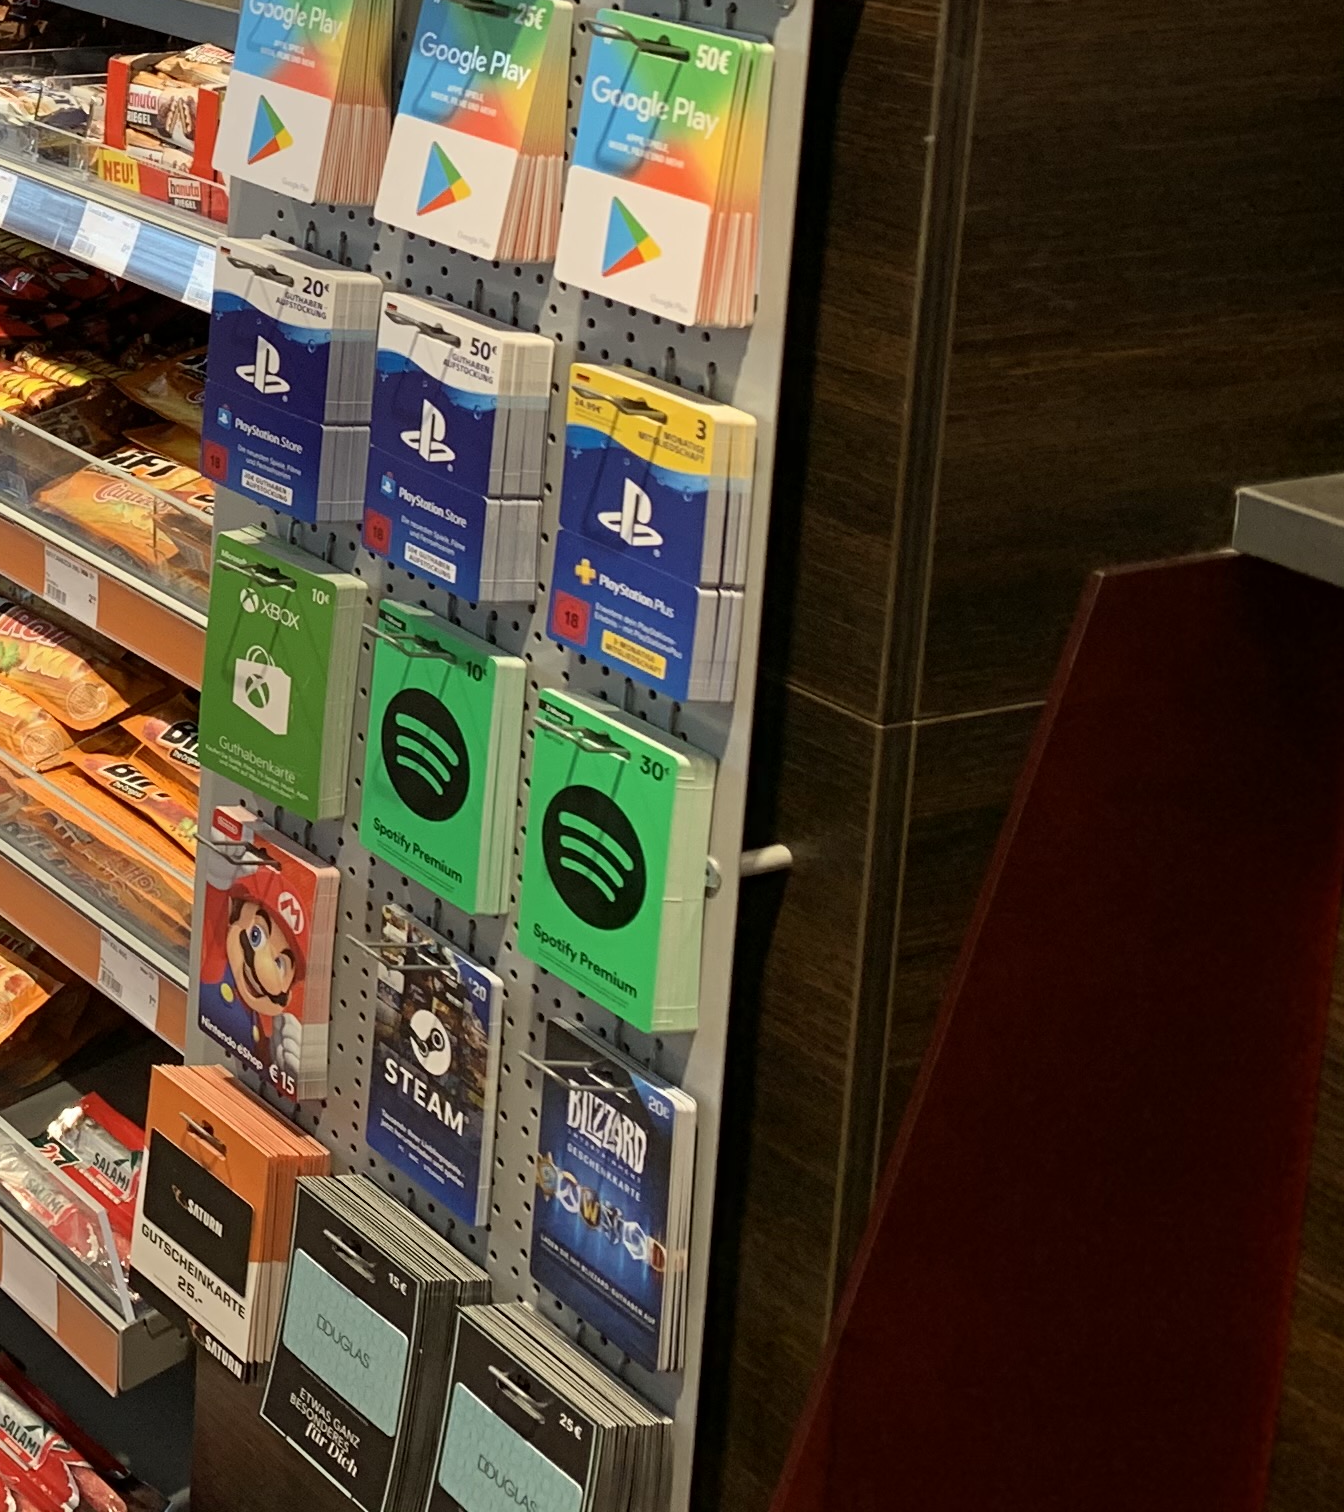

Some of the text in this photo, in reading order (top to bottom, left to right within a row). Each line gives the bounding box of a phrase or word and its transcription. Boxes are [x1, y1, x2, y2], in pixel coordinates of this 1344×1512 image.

[309, 6, 343, 41] Play
[418, 31, 532, 90] Google Play
[591, 73, 721, 141] Google Play
[102, 161, 135, 185] NEU!
[169, 179, 201, 199] hanuta
[174, 197, 198, 211] RIEGEL
[275, 296, 328, 321] AUFSTOCKUNG
[301, 276, 330, 299] 20€
[442, 359, 494, 385] AUFSTOCKUNG
[234, 417, 281, 445] PlayStation
[695, 419, 707, 441] 3
[398, 486, 445, 519] PlayStation
[260, 598, 301, 631] XBOX
[598, 572, 675, 619] PlayStation Plus
[218, 735, 296, 785] Guthabenkarte
[373, 816, 463, 884] Spotify Premium
[532, 921, 639, 999] Spotify Premium
[200, 1014, 263, 1072] Nintendo eShop
[384, 1057, 464, 1137] STEAM
[647, 1094, 670, 1121] 20€
[566, 1078, 648, 1175] BLIZZARD
[567, 1142, 642, 1203] GESCHENKKARTE
[187, 1198, 223, 1239] SATURN
[141, 1223, 247, 1320] GUTSCHEINKARTE
[177, 1275, 203, 1305] 25.-
[204, 1335, 243, 1381] SATURN
[316, 1313, 371, 1370] DOUGLAS
[0, 1414, 41, 1458] SALAMI
[289, 1392, 350, 1454] BESONDERES
[299, 1387, 361, 1449] ETWAS GANZ
[304, 1422, 359, 1478] für Dich
[476, 1453, 538, 1512] DOUGLAS
